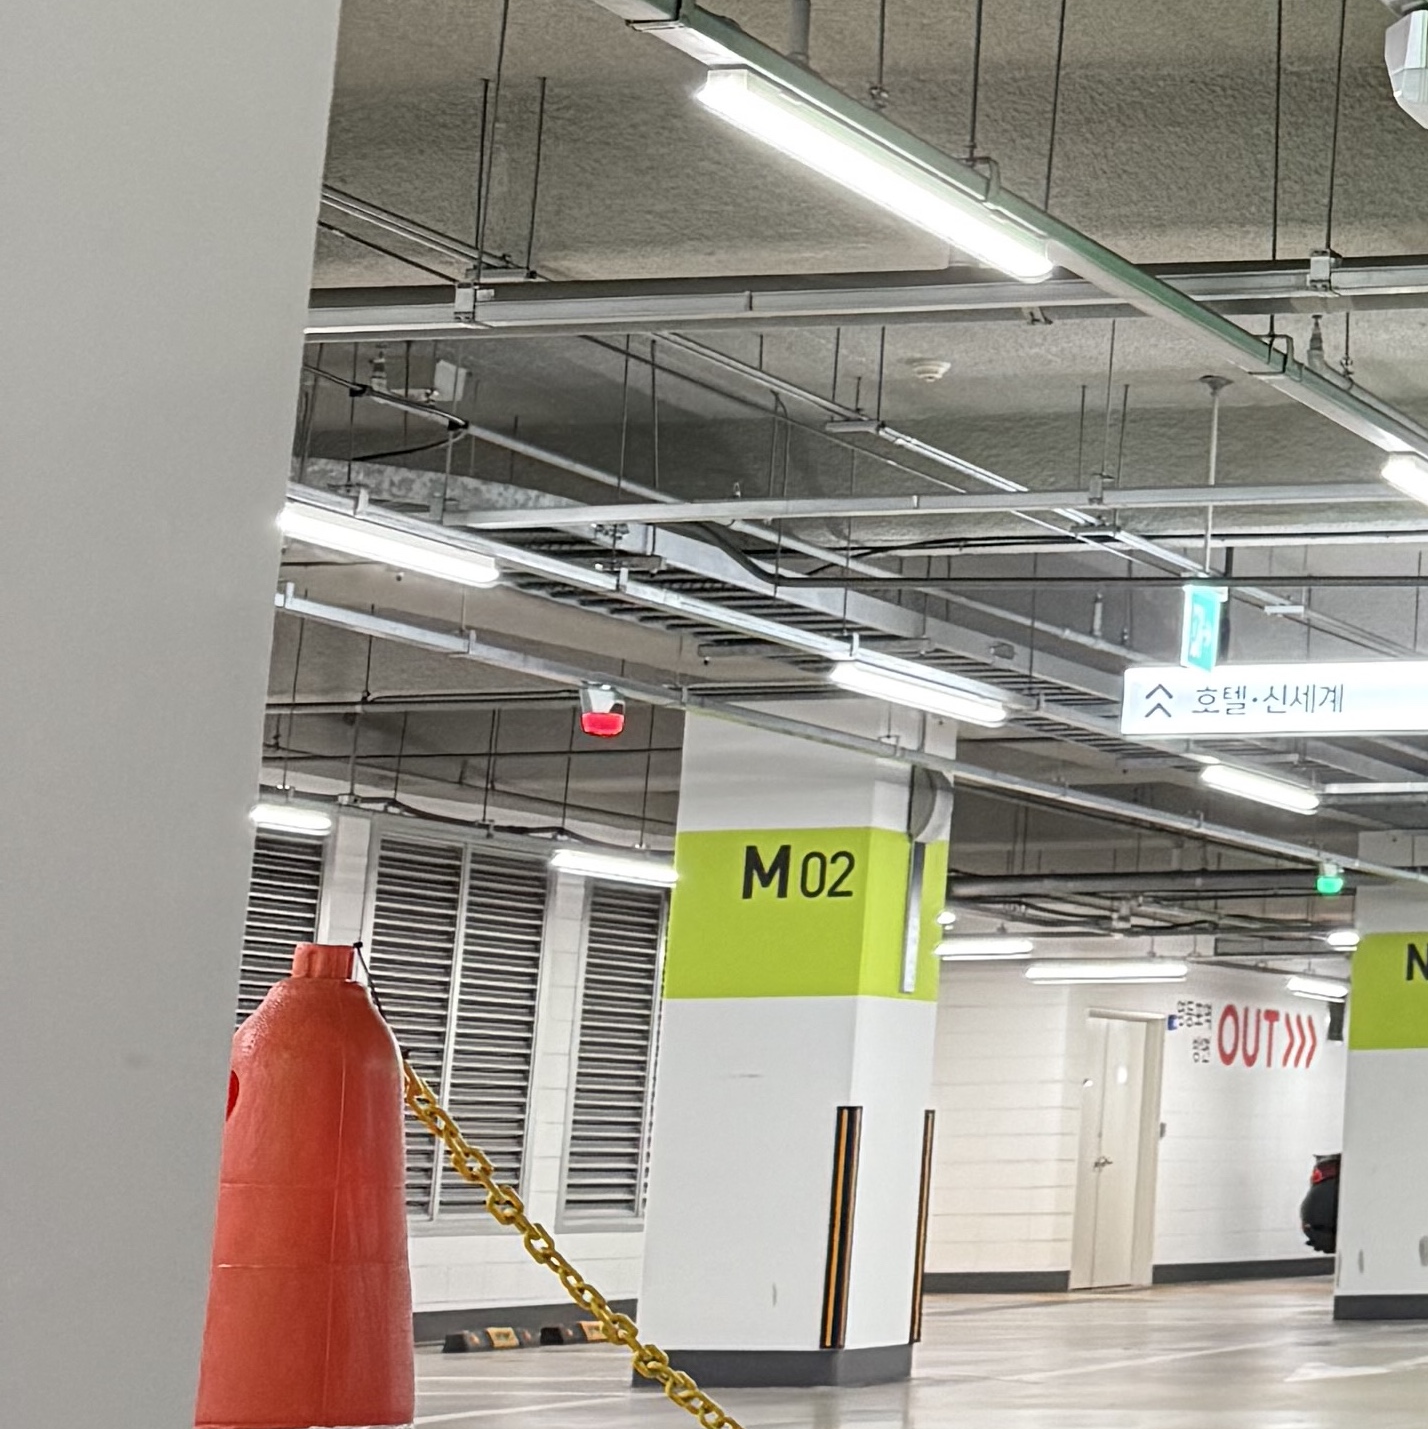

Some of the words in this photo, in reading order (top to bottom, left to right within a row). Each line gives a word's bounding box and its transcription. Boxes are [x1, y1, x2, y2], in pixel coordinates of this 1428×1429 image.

[1192, 683, 1344, 715] 호텔·신세계
[742, 844, 791, 899] M
[800, 850, 855, 898] 02
[1217, 1003, 1281, 1068] OUT
